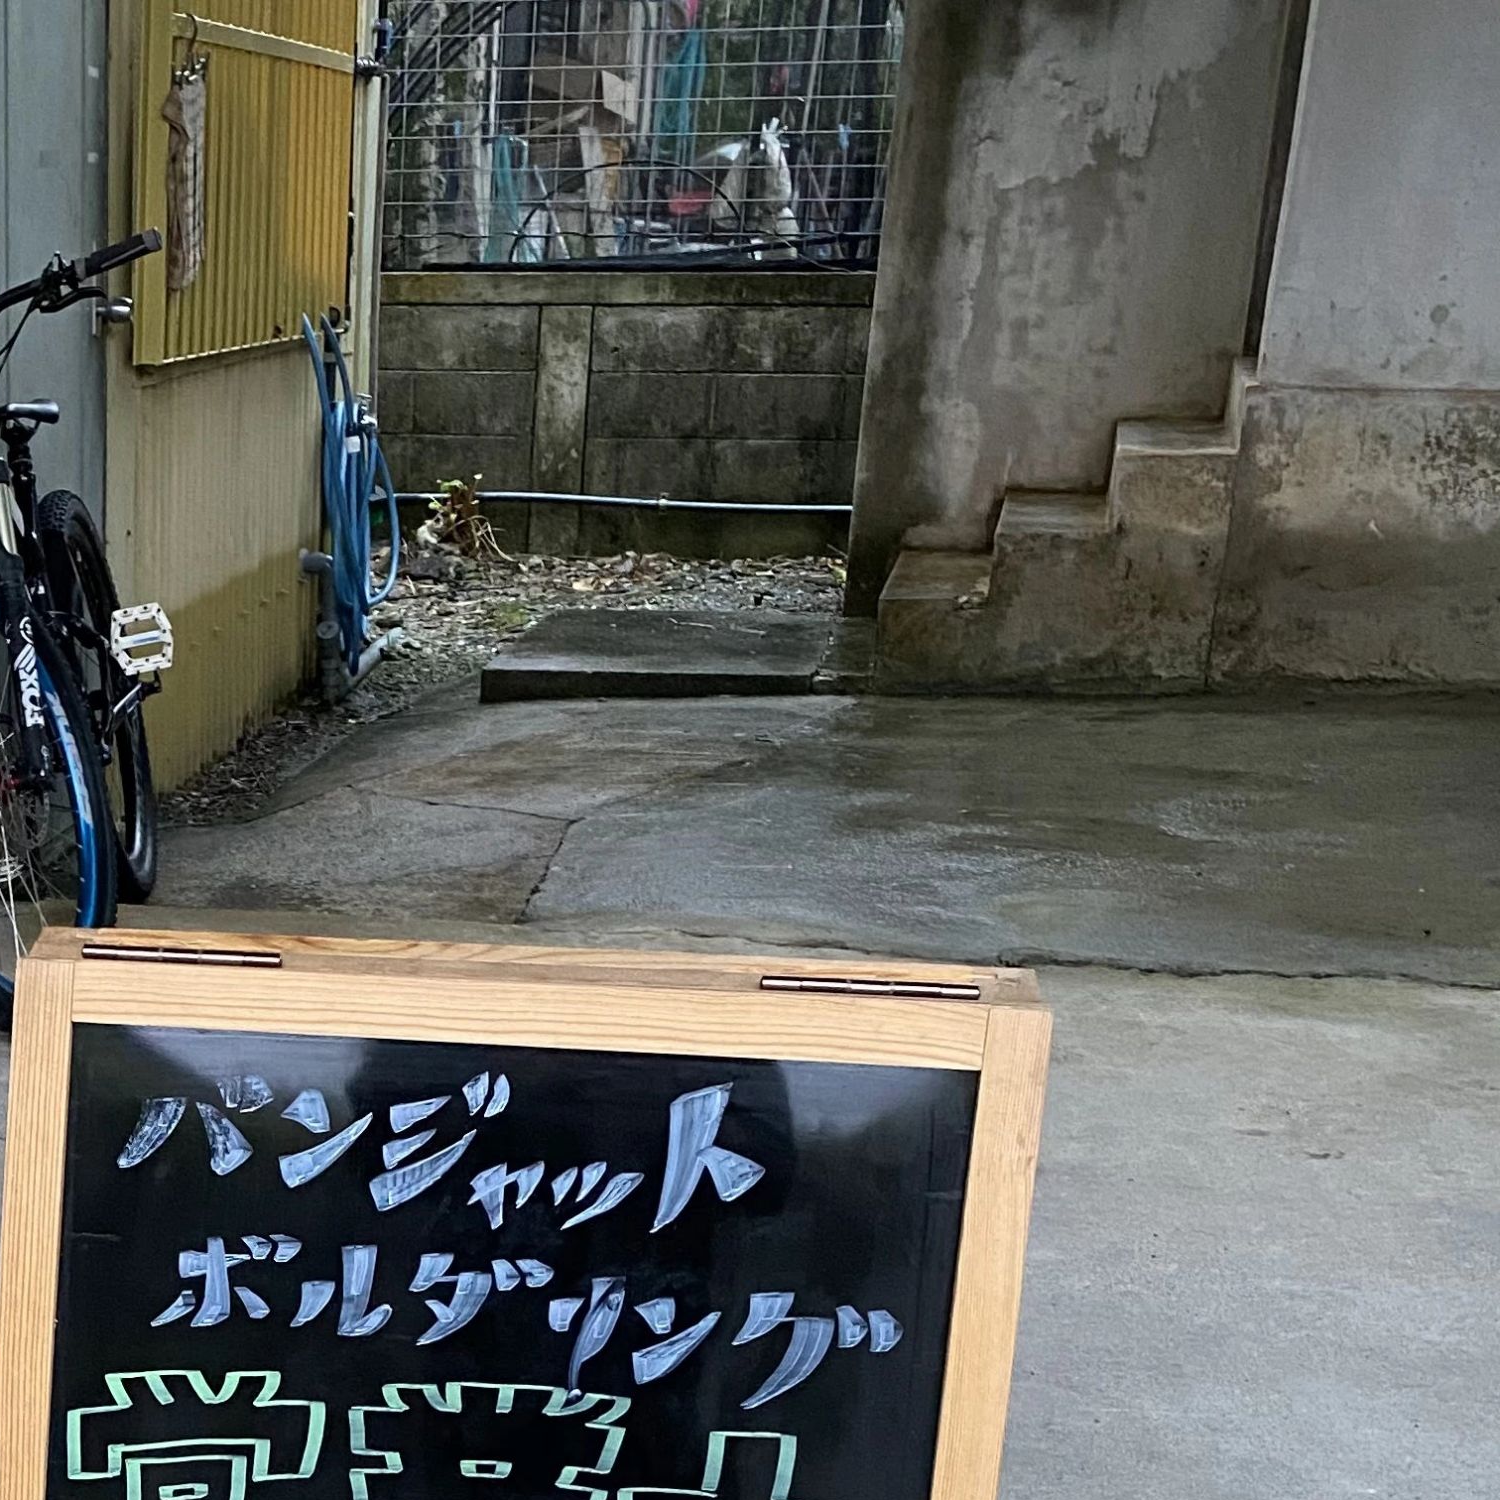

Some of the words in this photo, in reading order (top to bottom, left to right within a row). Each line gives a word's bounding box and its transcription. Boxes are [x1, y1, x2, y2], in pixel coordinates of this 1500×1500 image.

[150, 1233, 904, 1410] ボルダリング
